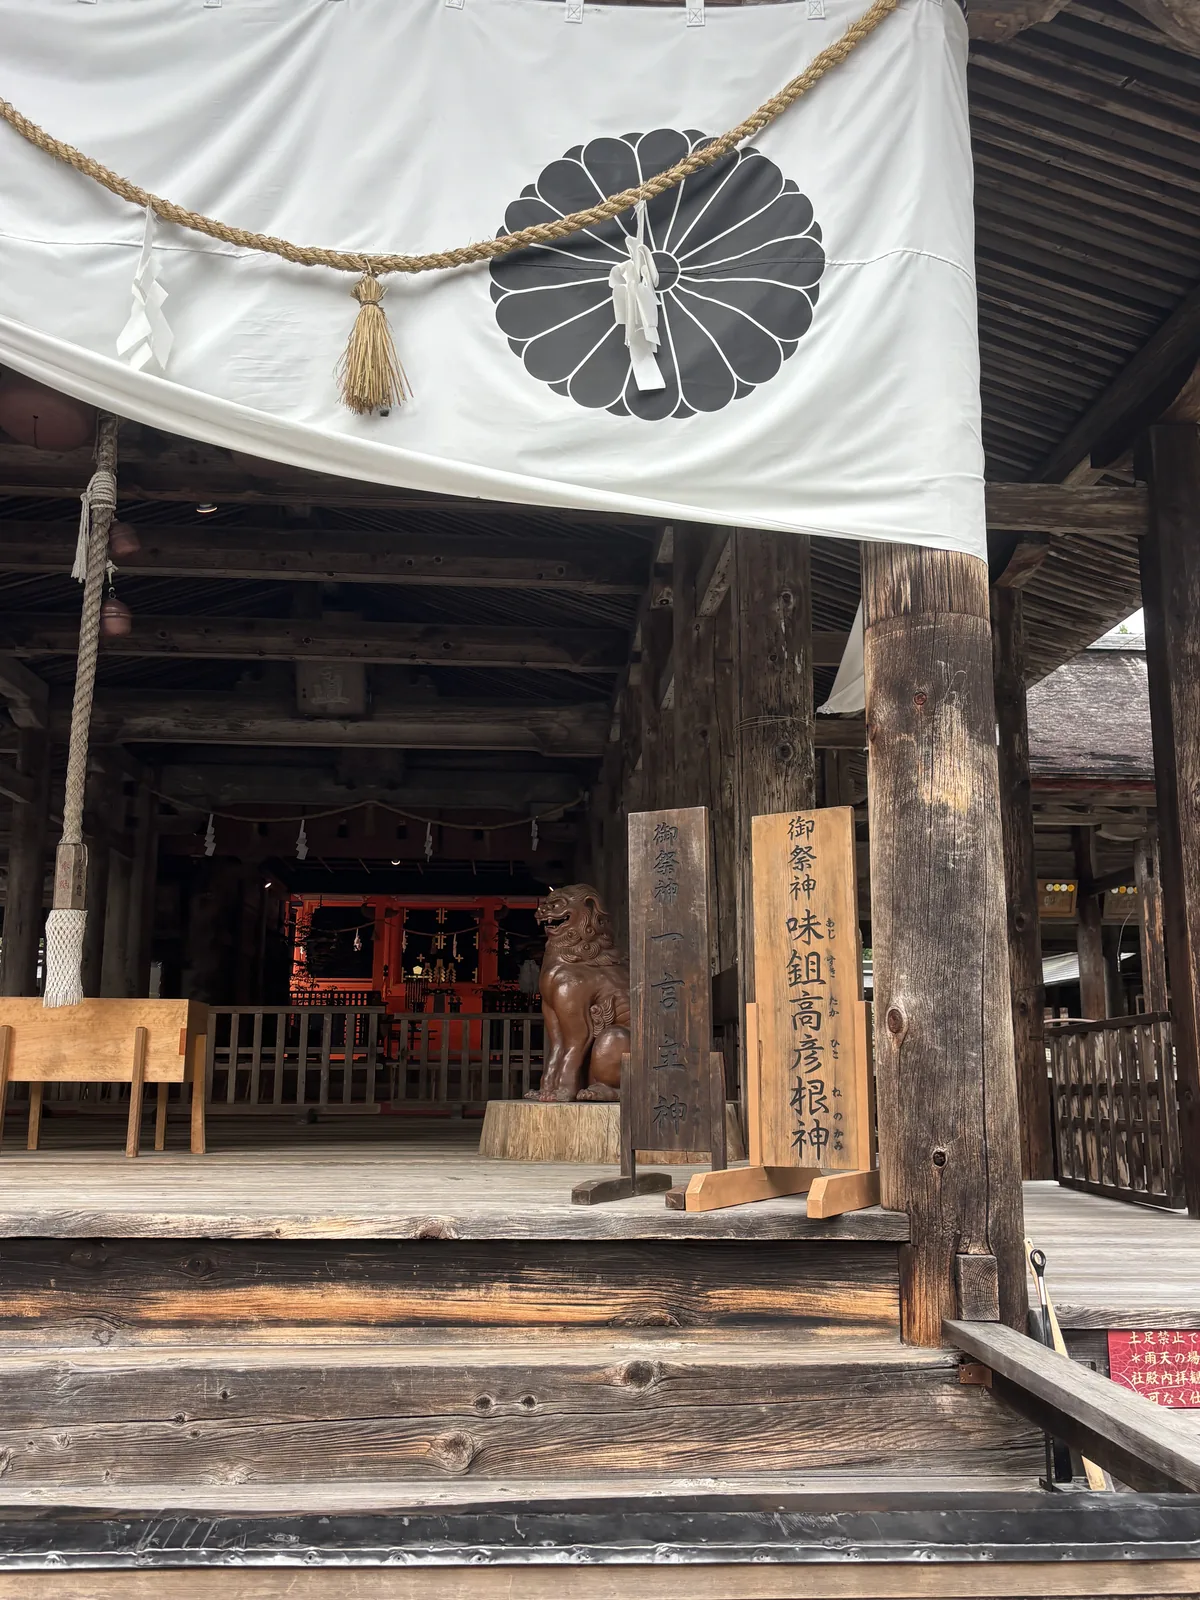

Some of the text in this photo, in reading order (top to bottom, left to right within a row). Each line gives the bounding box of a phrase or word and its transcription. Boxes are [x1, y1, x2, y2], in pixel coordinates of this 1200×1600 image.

[653, 822, 680, 903] 御祭神
[787, 816, 817, 901] 御祭神
[650, 931, 688, 1135] 一言主神
[1128, 1331, 1199, 1345] 土足禁止で
[1138, 1390, 1200, 1404] 可なく仕
